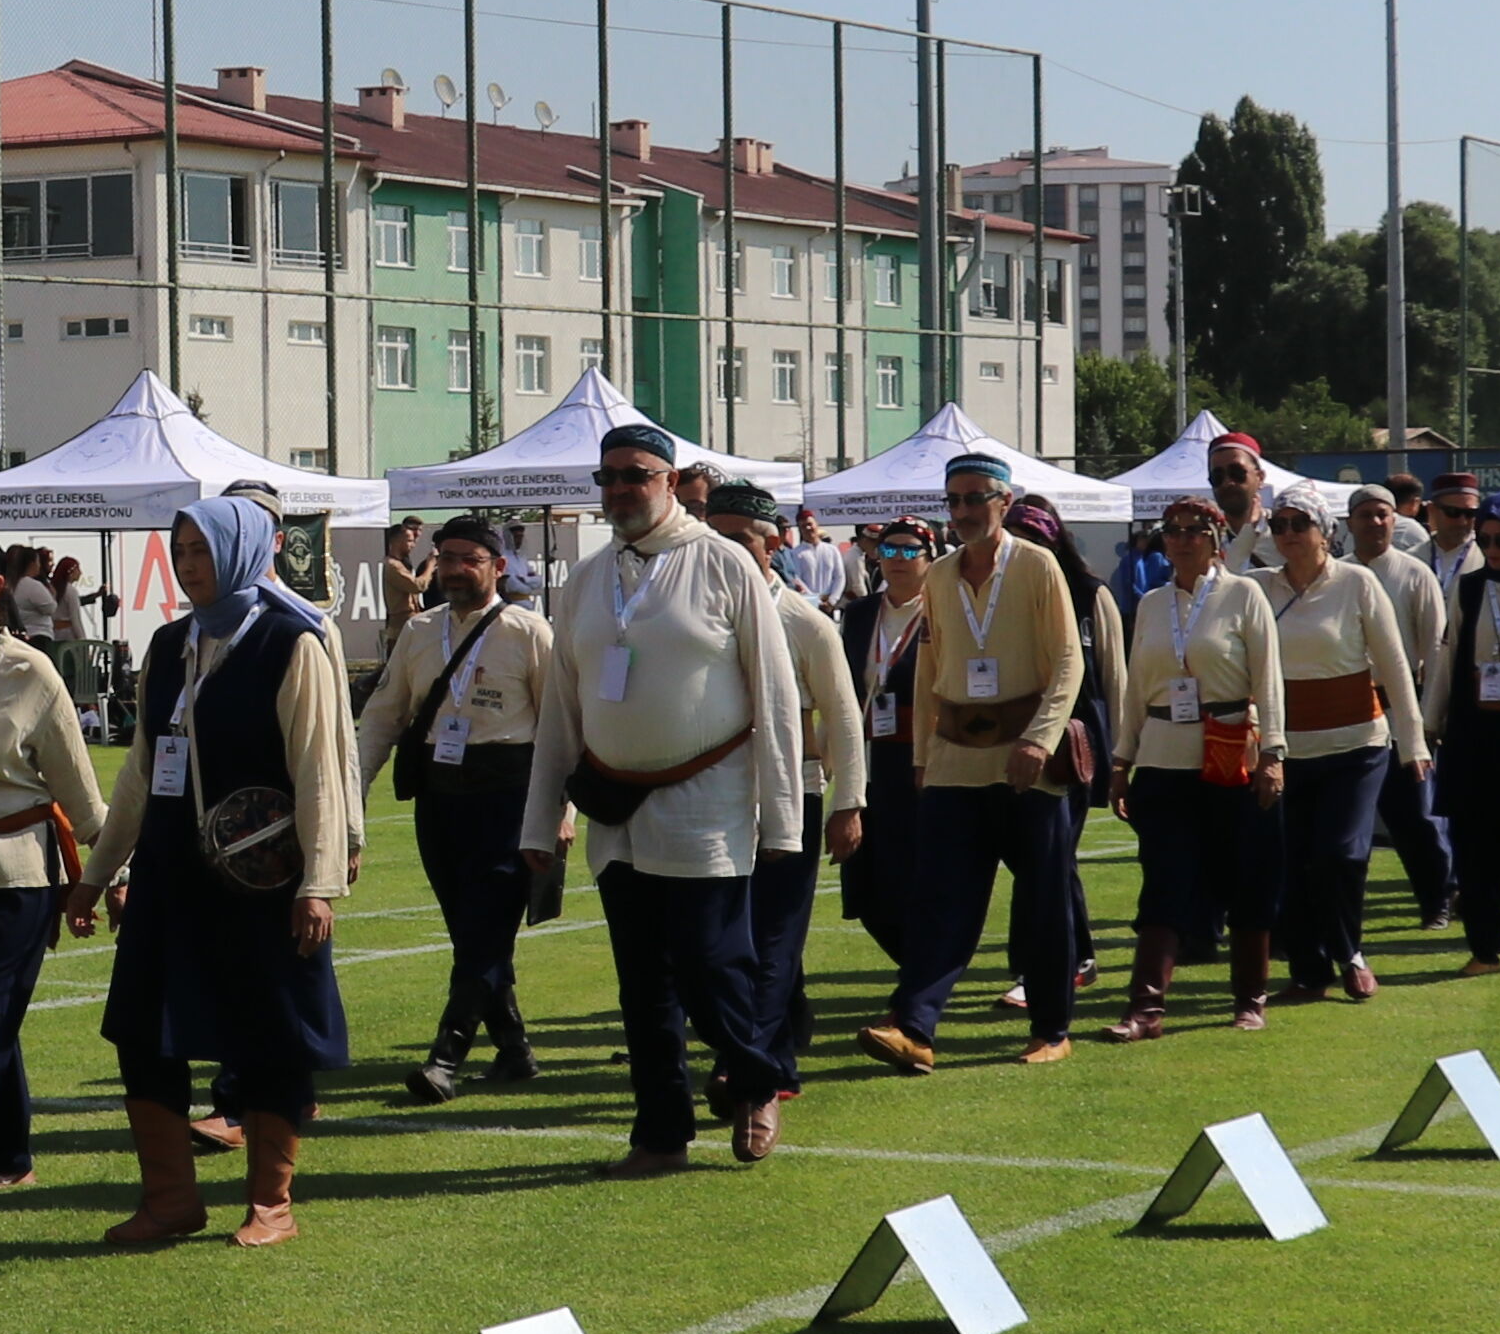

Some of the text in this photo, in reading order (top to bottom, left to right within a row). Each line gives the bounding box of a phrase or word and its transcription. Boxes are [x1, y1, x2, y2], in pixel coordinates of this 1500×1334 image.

[458, 474, 568, 487] TÜRKİYE GELENEKSEL
[35, 492, 106, 504] GELENEKSEL
[438, 486, 591, 500] TÜRK OKÇULUK FEDERASYONU
[51, 506, 133, 519] FEDERASYONU
[820, 506, 844, 516] TÜRK
